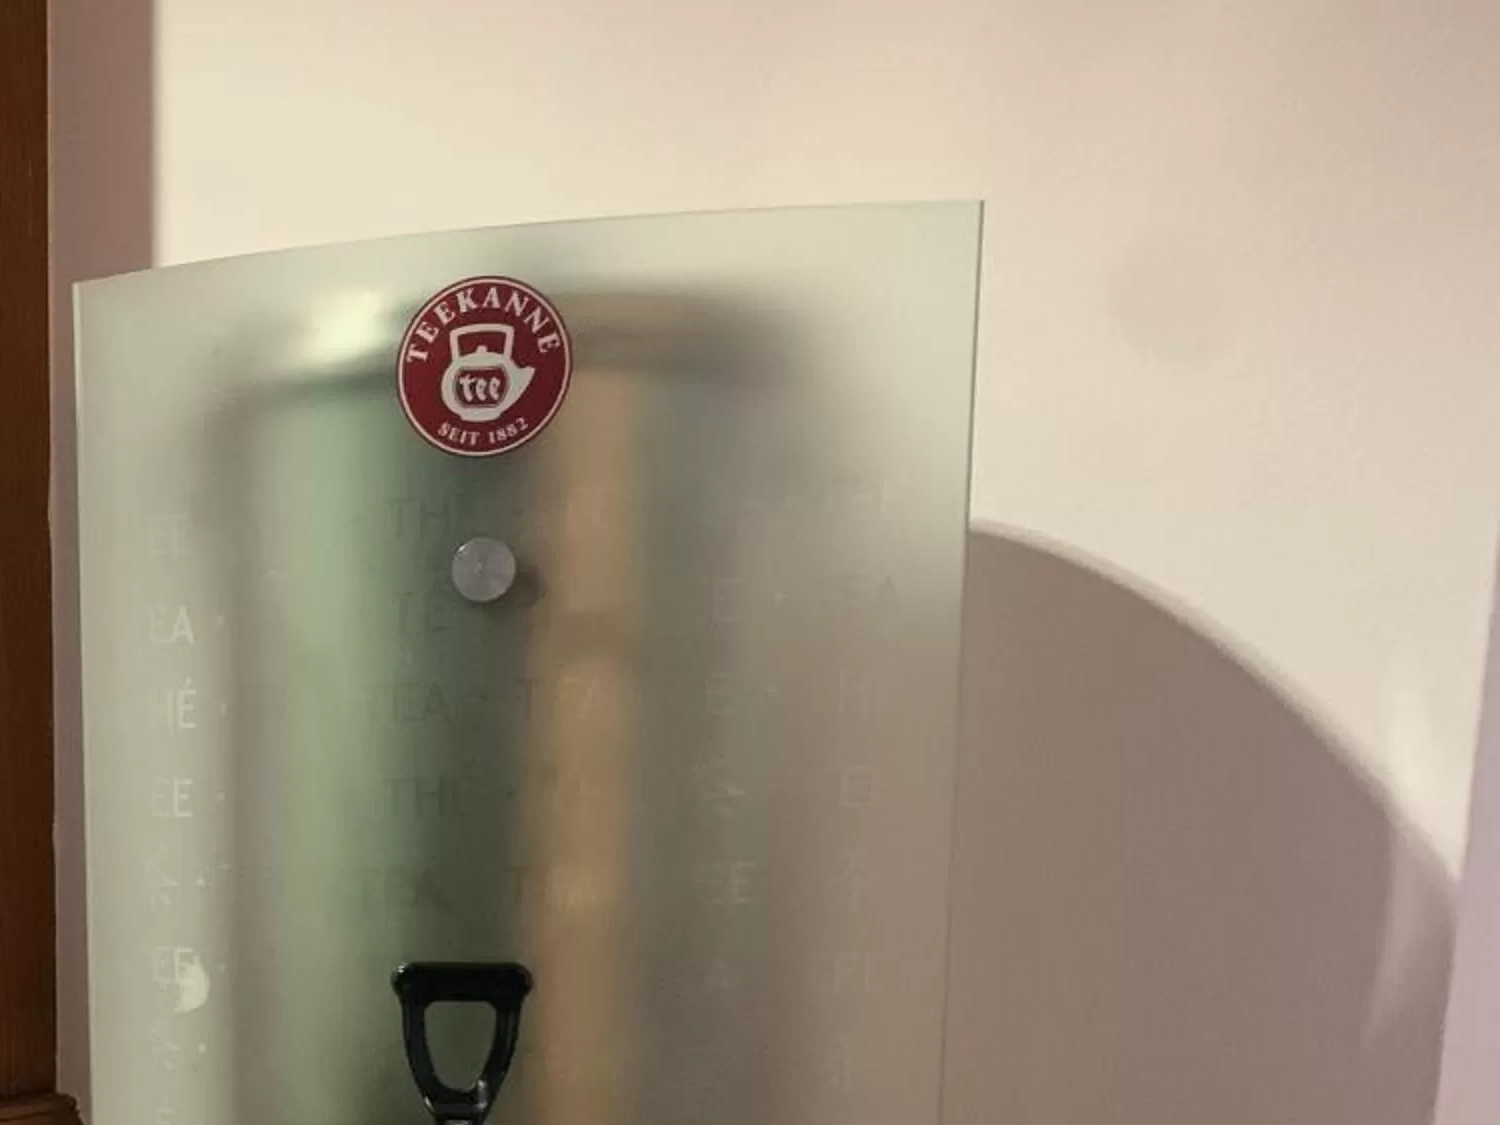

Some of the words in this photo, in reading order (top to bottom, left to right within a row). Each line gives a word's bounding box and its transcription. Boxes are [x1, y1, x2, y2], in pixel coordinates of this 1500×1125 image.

[406, 286, 561, 364] TEEKANNE
[459, 373, 501, 402] tee
[437, 421, 481, 446] SEIT
[488, 416, 529, 445] 1882
